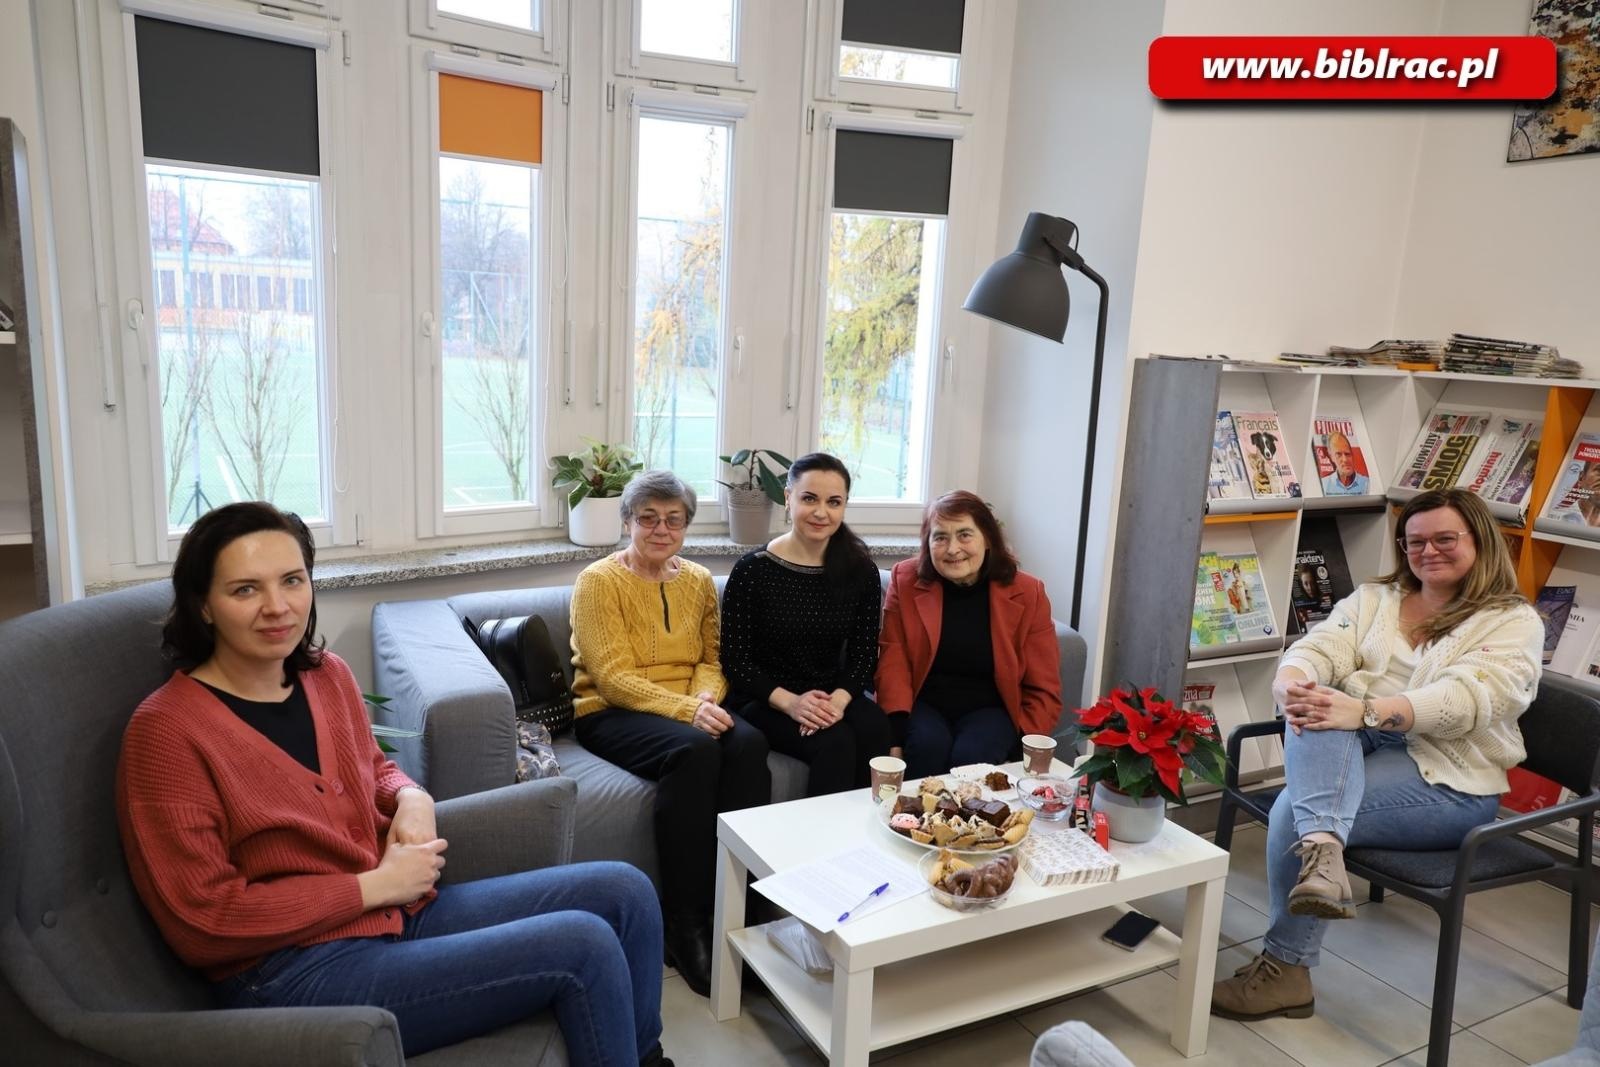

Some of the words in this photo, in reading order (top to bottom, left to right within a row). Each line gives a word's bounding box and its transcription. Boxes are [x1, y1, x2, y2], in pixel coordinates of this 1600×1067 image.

[1237, 415, 1279, 433] Français
[1412, 432, 1441, 469] nowiny
[1423, 434, 1468, 490] SMOG
[1467, 450, 1502, 493] nowiny
